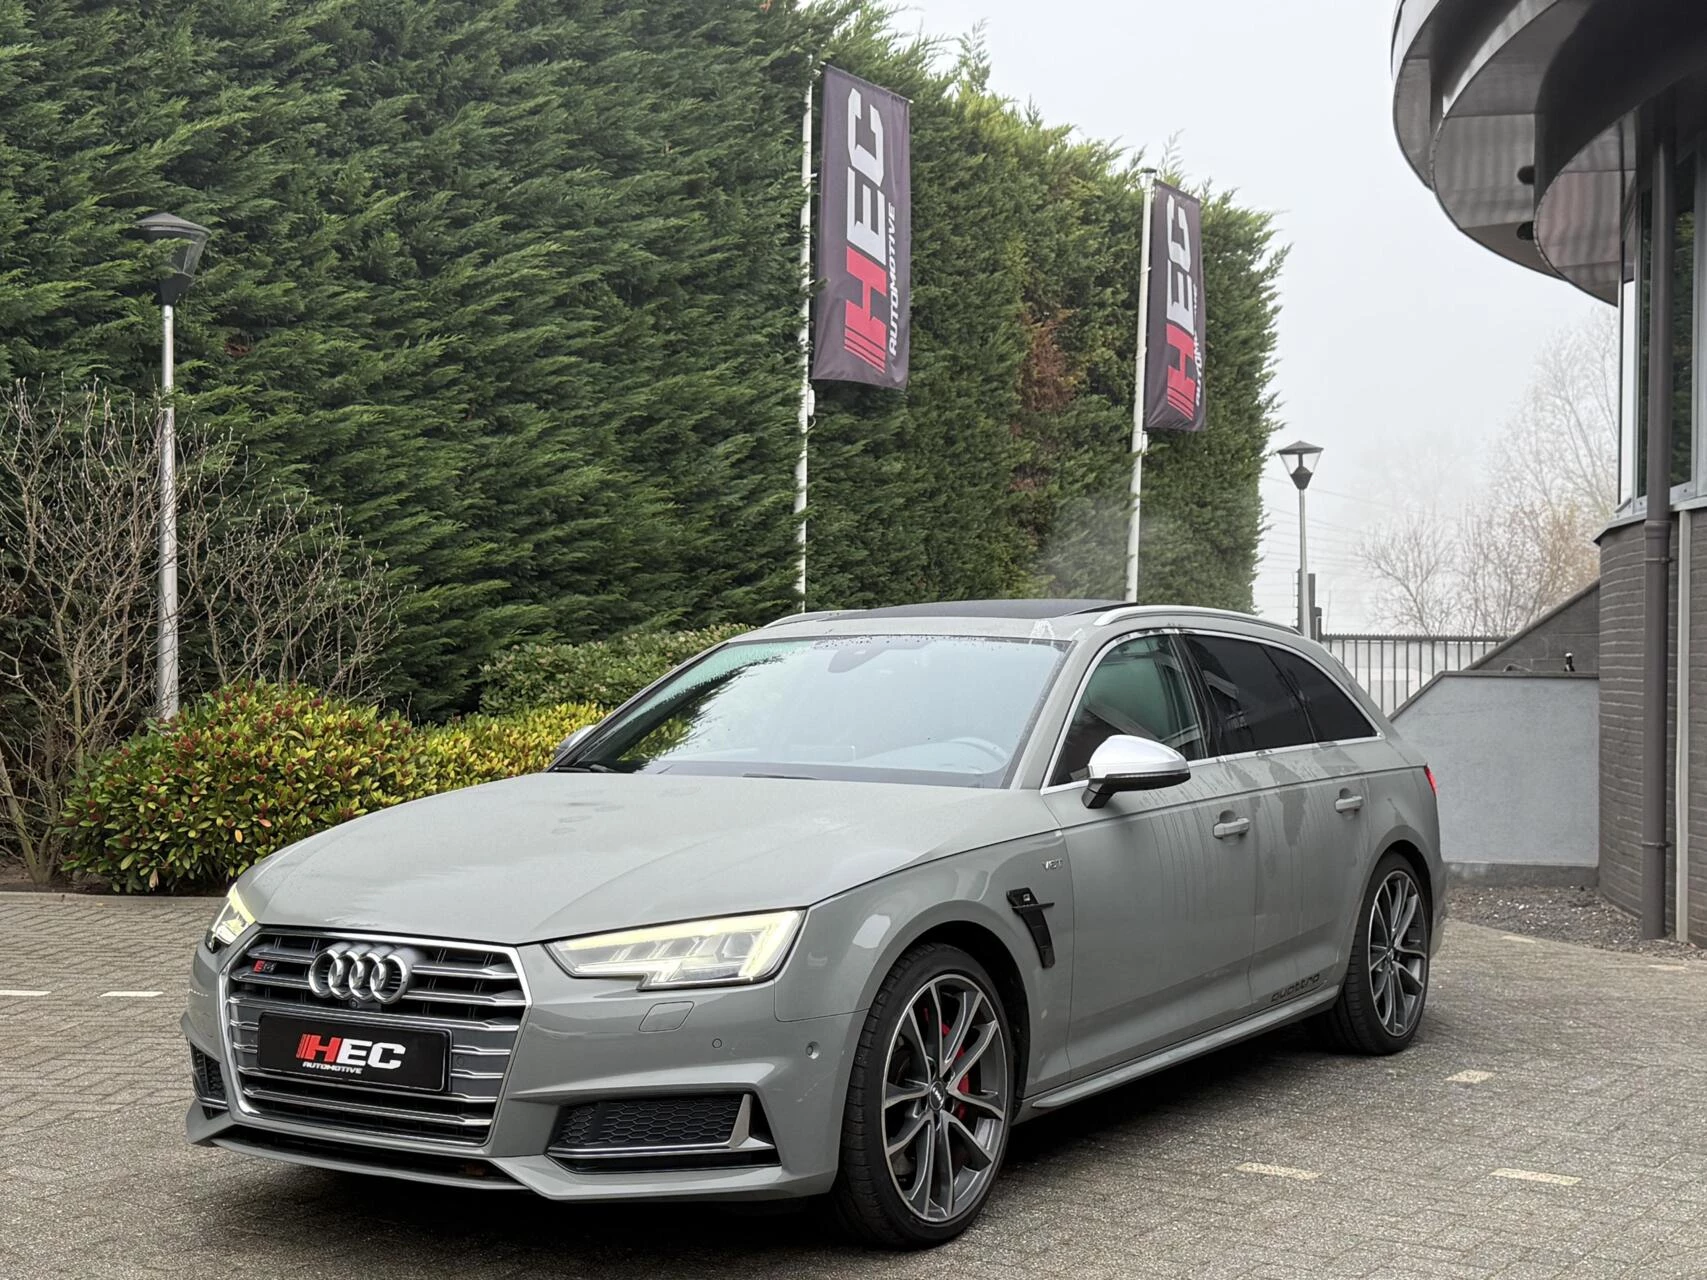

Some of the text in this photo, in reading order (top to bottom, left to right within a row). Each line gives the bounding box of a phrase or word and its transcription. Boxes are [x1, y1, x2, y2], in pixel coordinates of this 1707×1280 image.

[845, 87, 887, 374] HEC
[888, 202, 898, 357] AUTOMOTIVE
[1166, 195, 1194, 421] HEC
[1271, 973, 1320, 1002] quattro
[297, 1033, 406, 1070] HEC
[302, 1061, 362, 1074] AUTOMOTIVE
